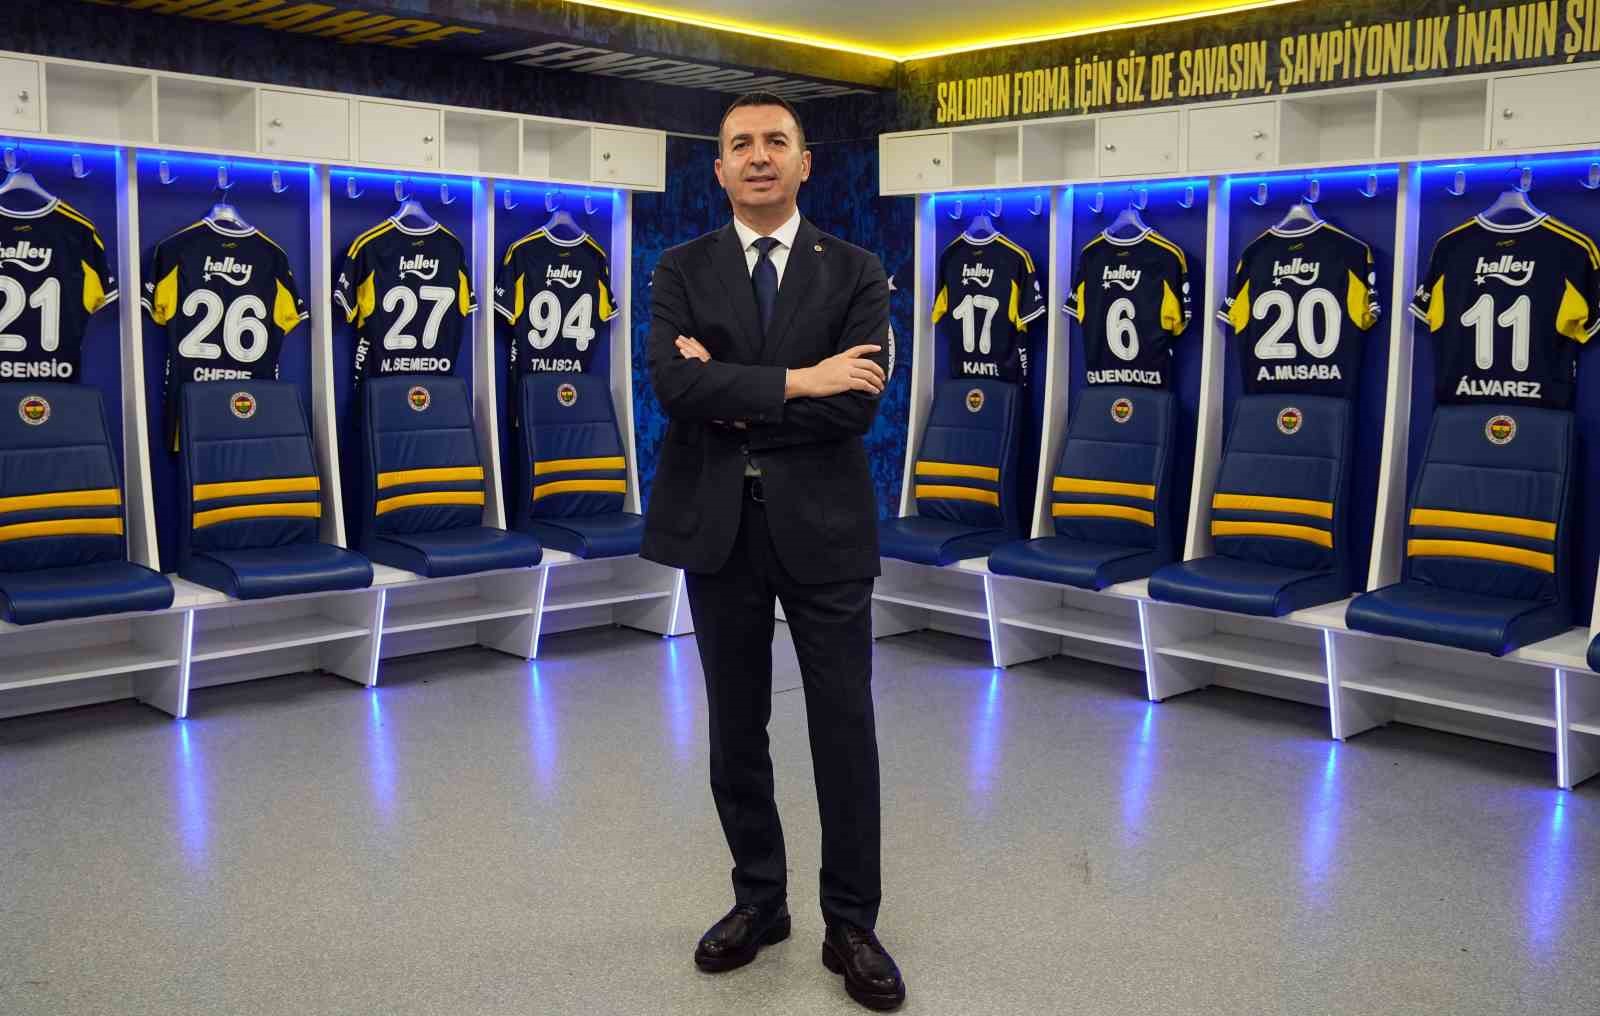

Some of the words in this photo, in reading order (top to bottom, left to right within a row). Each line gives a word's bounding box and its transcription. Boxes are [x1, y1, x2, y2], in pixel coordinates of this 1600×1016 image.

[937, 73, 1010, 122] SALDIRIN
[1013, 66, 1069, 115] FORMA
[1075, 56, 1113, 115] İÇİN
[1116, 50, 1147, 104] SİZ
[1151, 52, 1174, 101] DE
[1178, 40, 1272, 98] SAVAŞIN,
[1279, 15, 1450, 93] ŞAMPİYONLUK
[1455, 0, 1558, 67] İNANIN
[204, 256, 252, 286] halley
[399, 254, 439, 280] halley
[546, 264, 582, 288] halley
[962, 264, 994, 288] halley
[1102, 264, 1141, 291] halley
[1272, 258, 1320, 285] halley
[1475, 256, 1535, 286] halley
[178, 288, 269, 363] 26
[382, 286, 456, 350] 27
[527, 290, 596, 351] 94
[952, 294, 1000, 355] 17
[1106, 297, 1140, 361] 6
[1252, 288, 1342, 360] 20
[1460, 293, 1531, 372] 11
[381, 357, 451, 372] N.SEMEDO
[531, 358, 582, 372] TALISCA
[1087, 369, 1161, 384] GUENDOUZI
[1257, 365, 1342, 381] A.MUSABA
[1456, 376, 1542, 398] ÁLVAREZ
